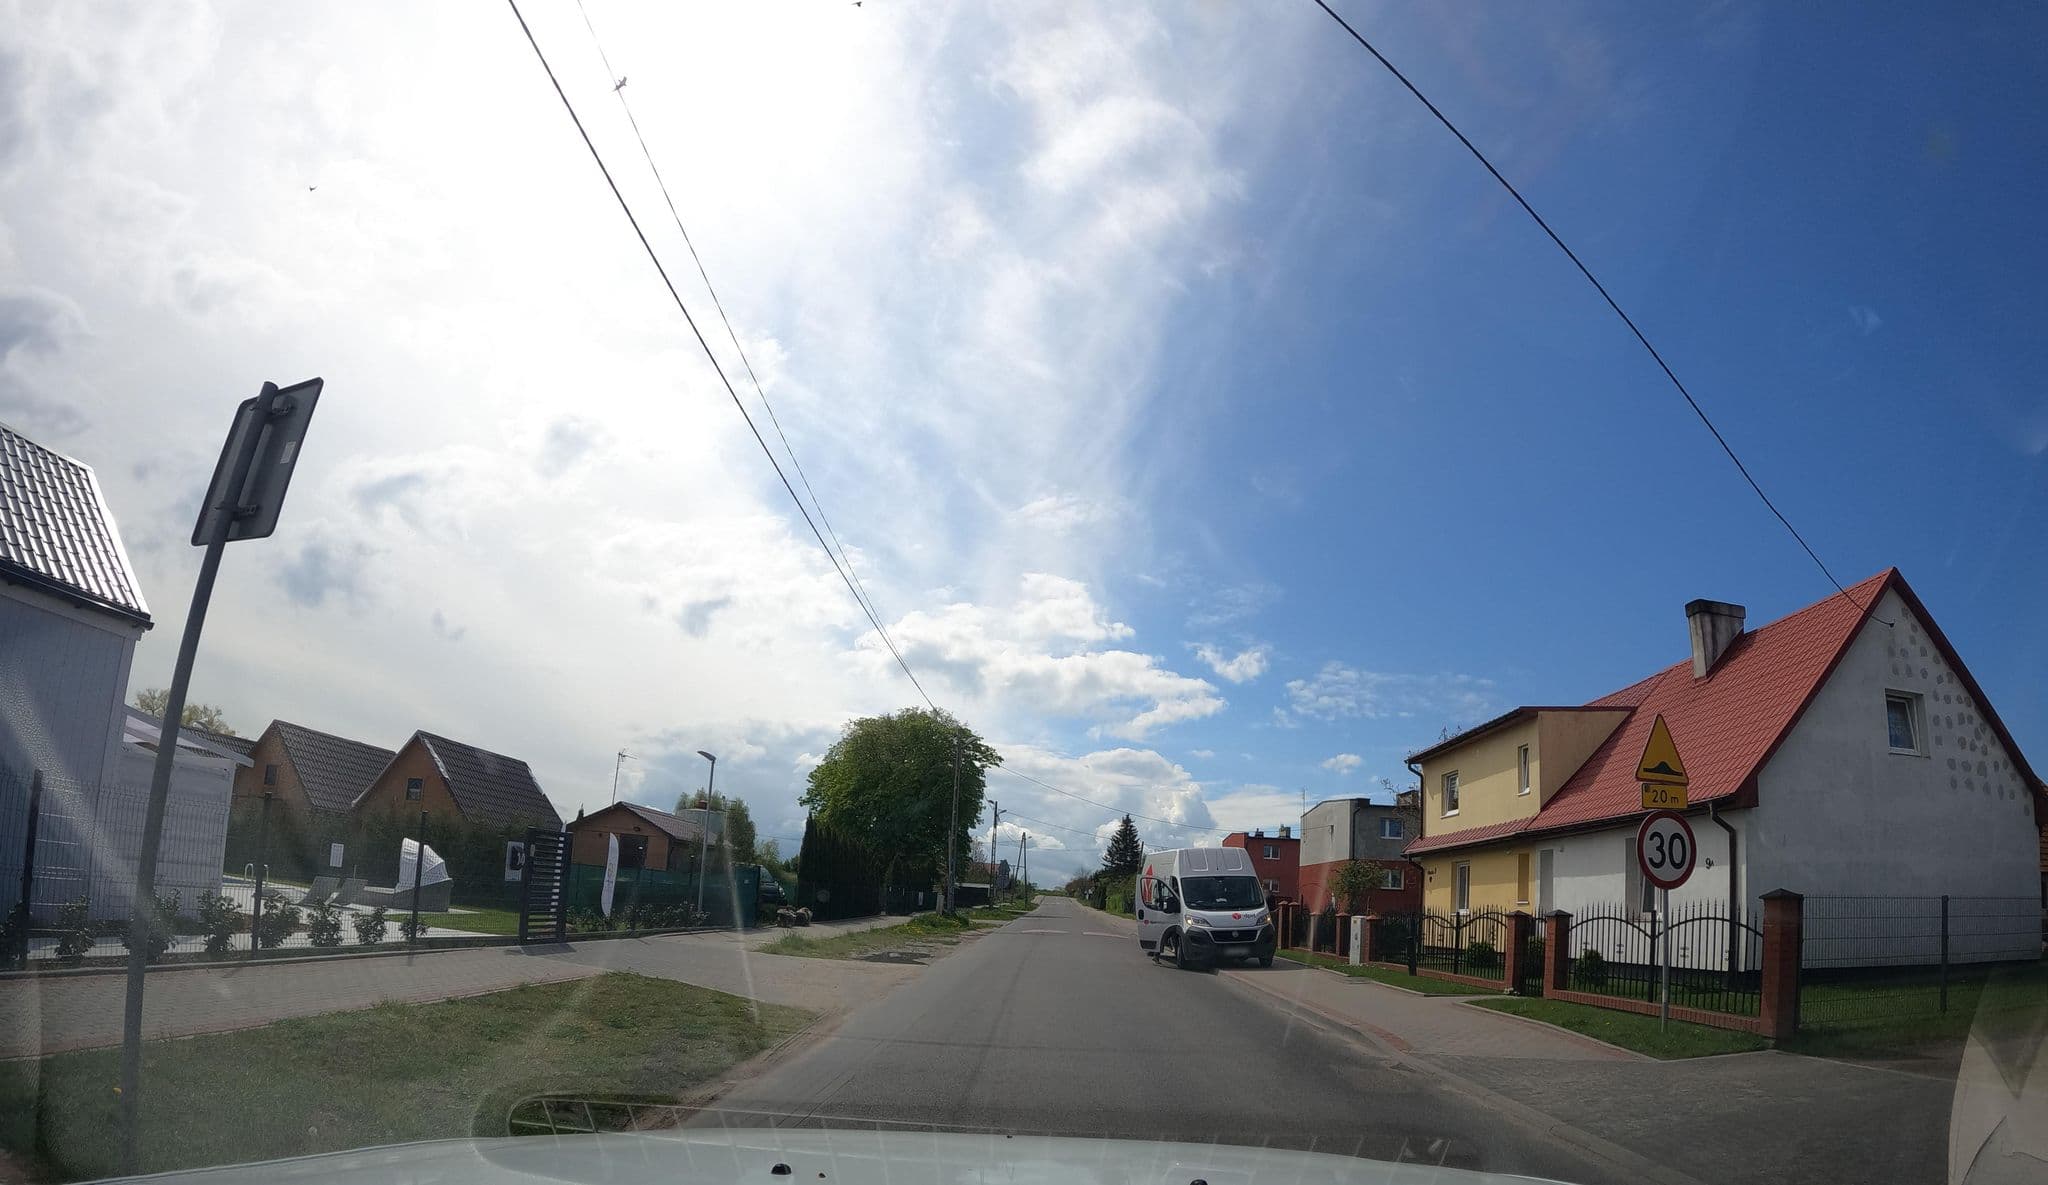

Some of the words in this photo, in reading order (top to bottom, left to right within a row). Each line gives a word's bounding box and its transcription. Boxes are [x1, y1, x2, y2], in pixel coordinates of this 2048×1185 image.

[1652, 789, 1668, 803] 20
[1670, 796, 1679, 804] m
[1648, 831, 1687, 869] 30
